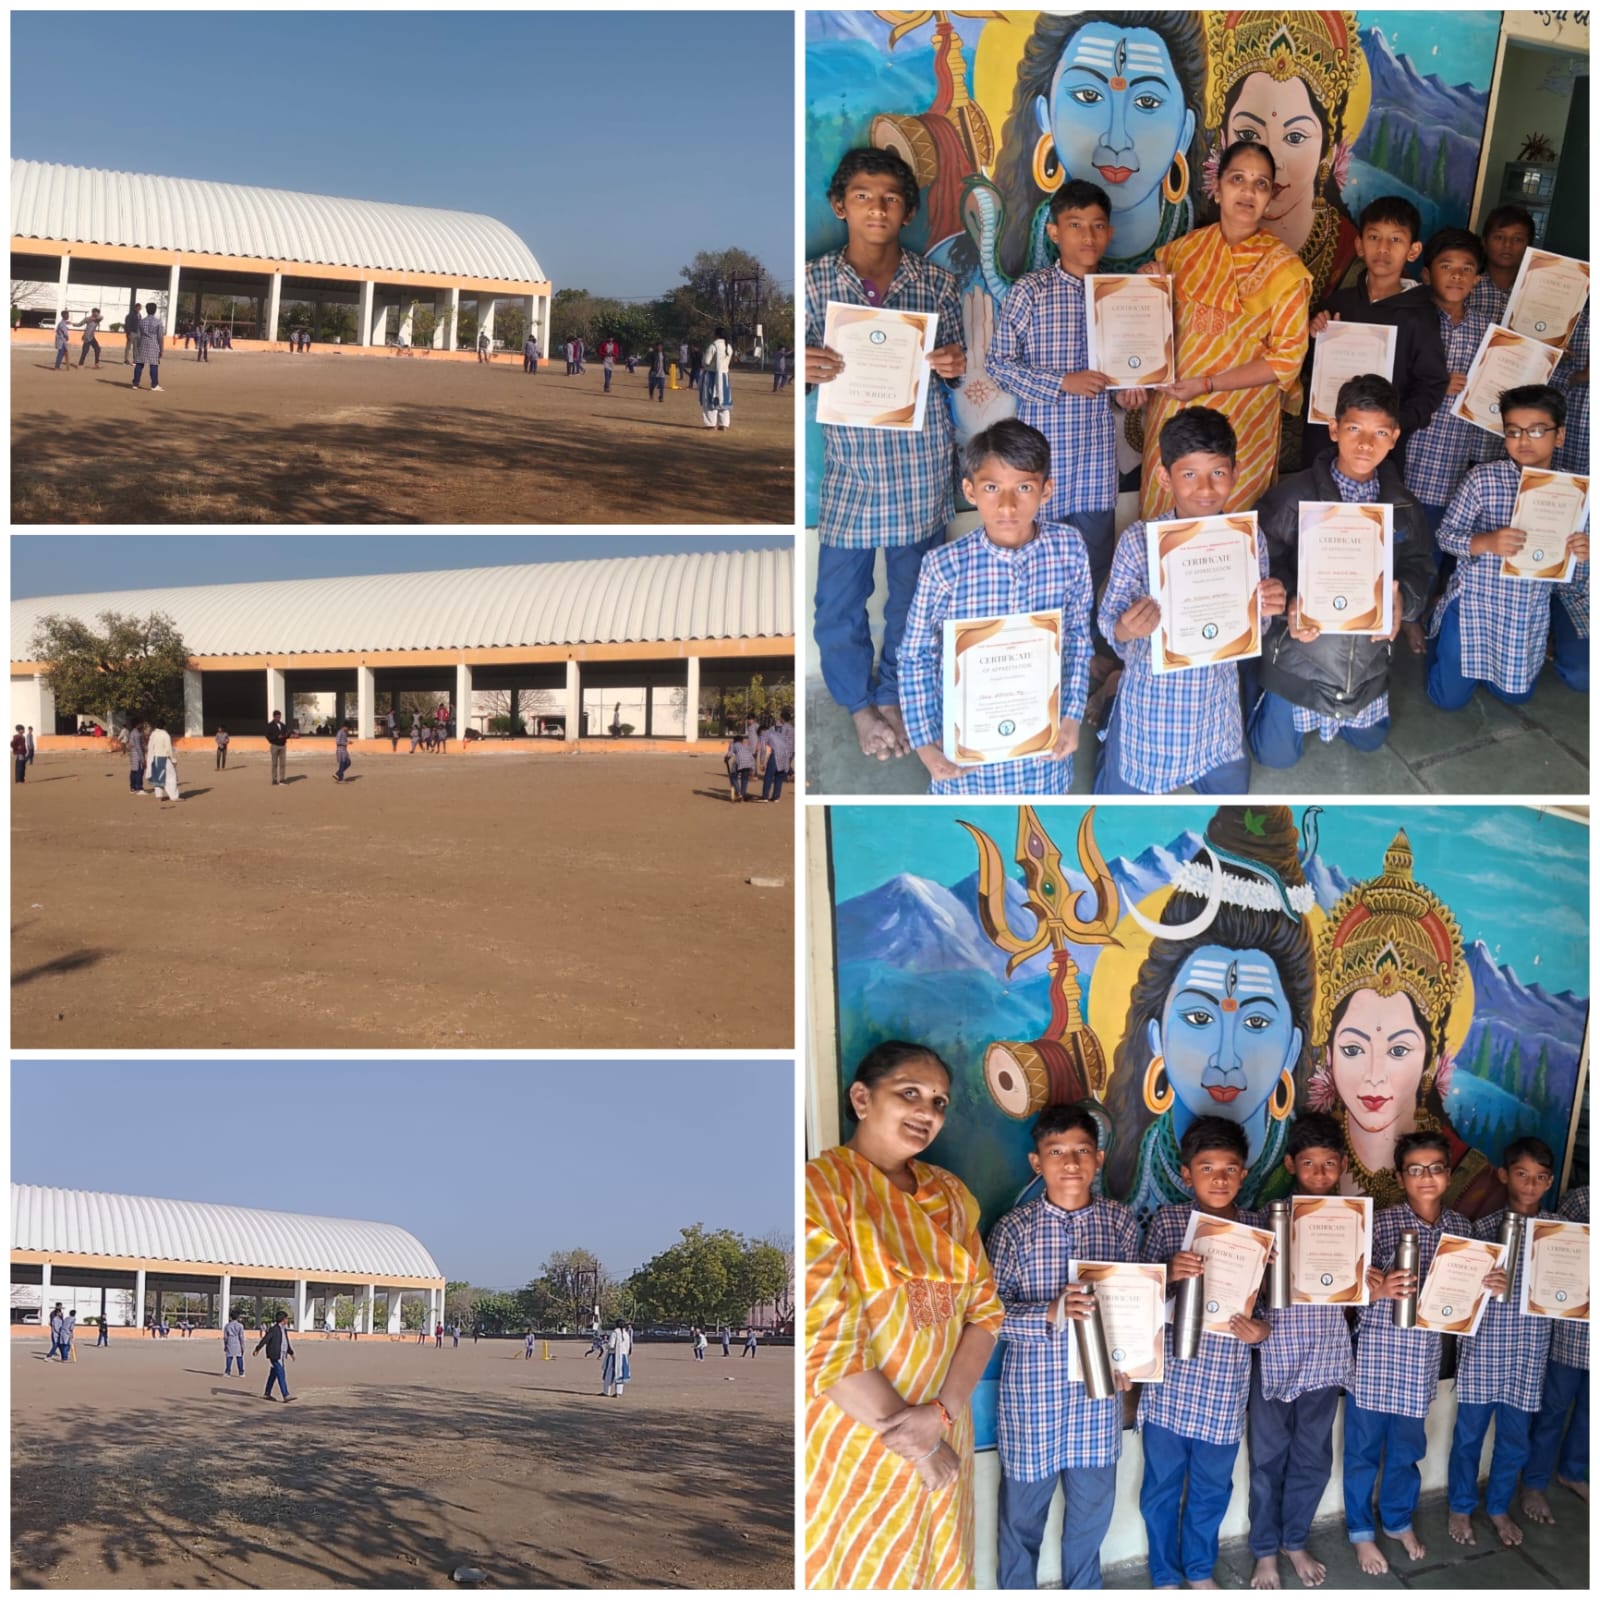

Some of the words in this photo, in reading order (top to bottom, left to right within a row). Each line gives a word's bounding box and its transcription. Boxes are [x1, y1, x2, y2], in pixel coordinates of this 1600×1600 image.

[1318, 536, 1361, 545] CERTIFICATE
[1182, 553, 1232, 567] CERTIFICATE
[979, 651, 1032, 665] CERTIFICATE
